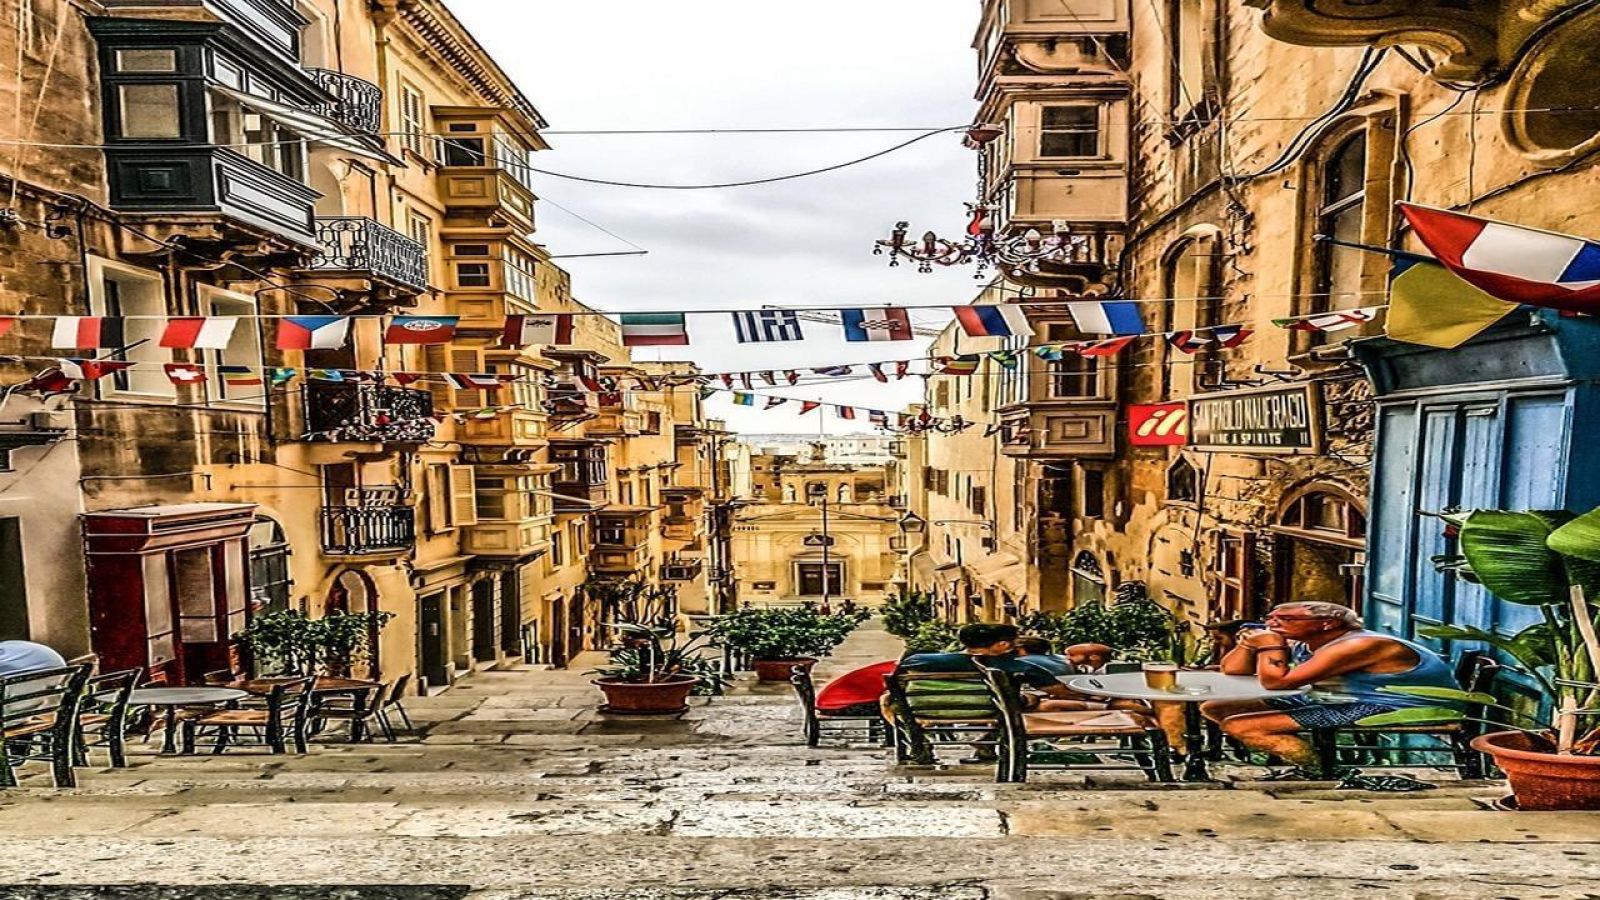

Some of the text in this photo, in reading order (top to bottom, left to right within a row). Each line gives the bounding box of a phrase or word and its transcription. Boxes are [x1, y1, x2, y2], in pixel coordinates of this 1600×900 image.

[1211, 399, 1243, 430] PAOLO
[1244, 393, 1307, 430] NAUFRAGO
[1240, 432, 1282, 444] SPIRITS
